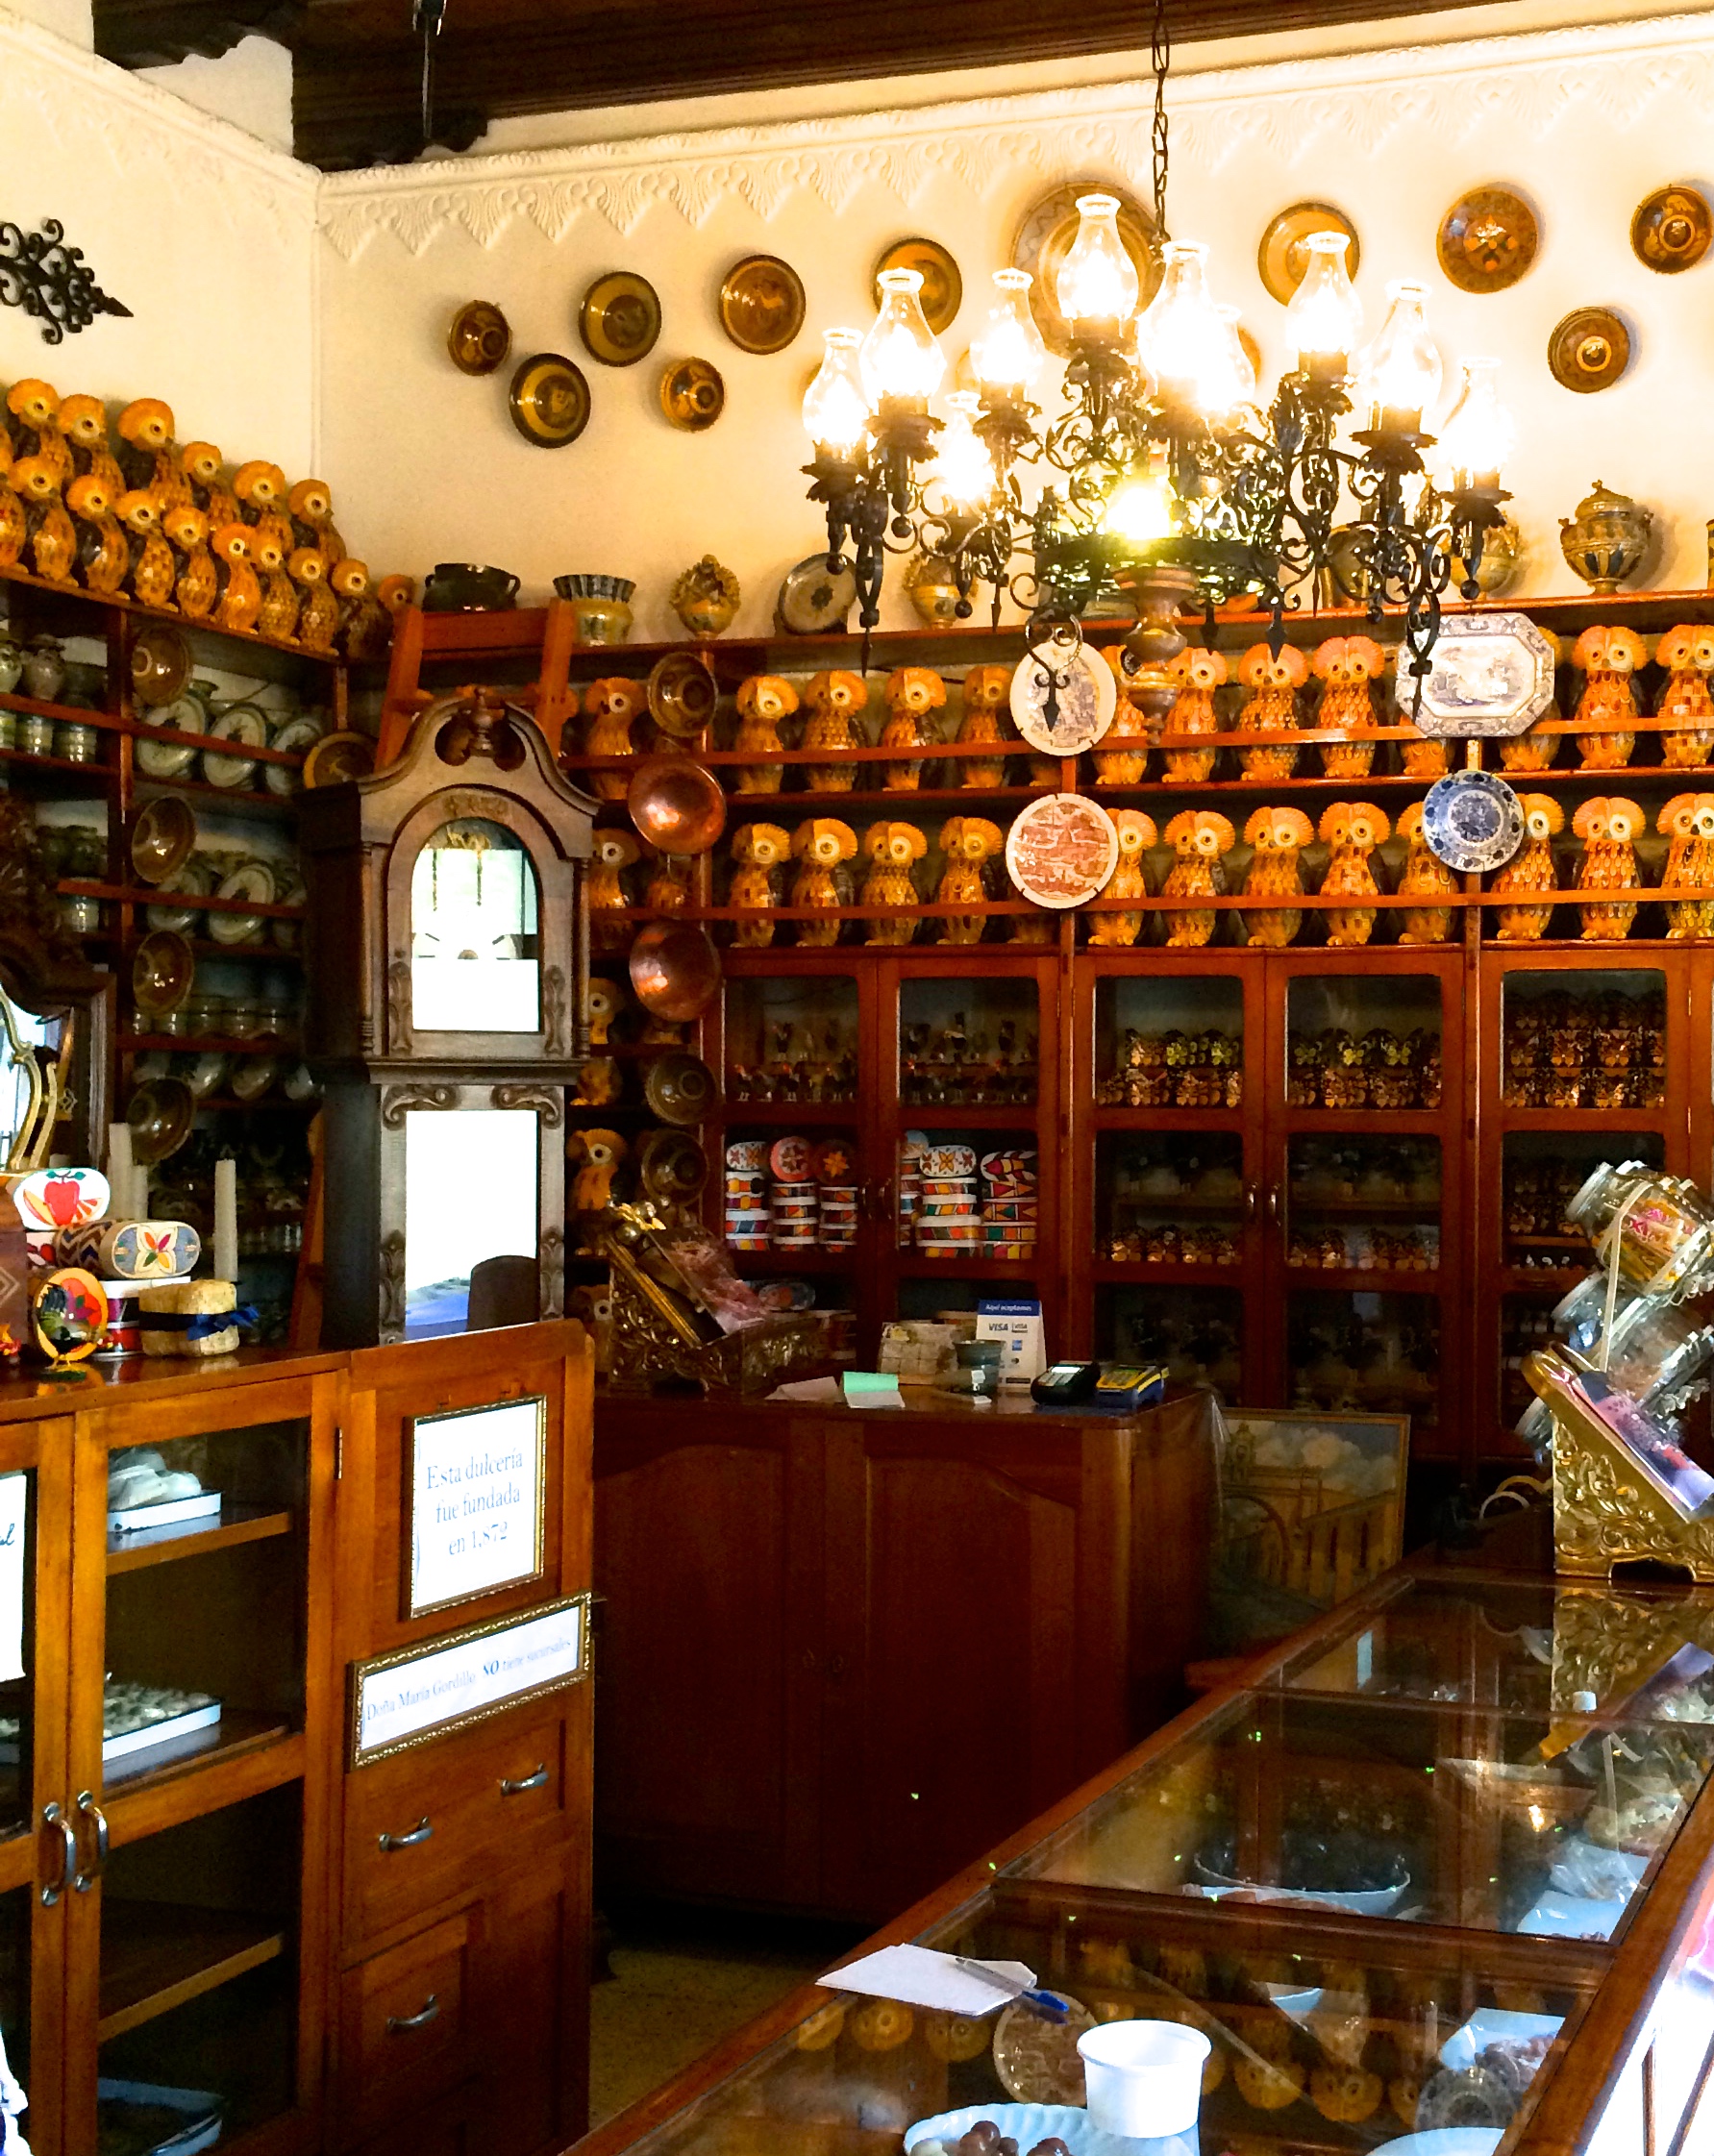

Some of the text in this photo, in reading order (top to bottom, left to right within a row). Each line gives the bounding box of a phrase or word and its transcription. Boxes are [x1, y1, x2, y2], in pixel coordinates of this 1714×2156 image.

[988, 1323, 1009, 1331] VISA
[427, 1447, 523, 1489] Esta dulcería
[435, 1481, 520, 1524] fue fundada
[448, 1537, 465, 1555] en
[366, 1699, 395, 1721] Doña
[483, 1660, 500, 1678] NO
